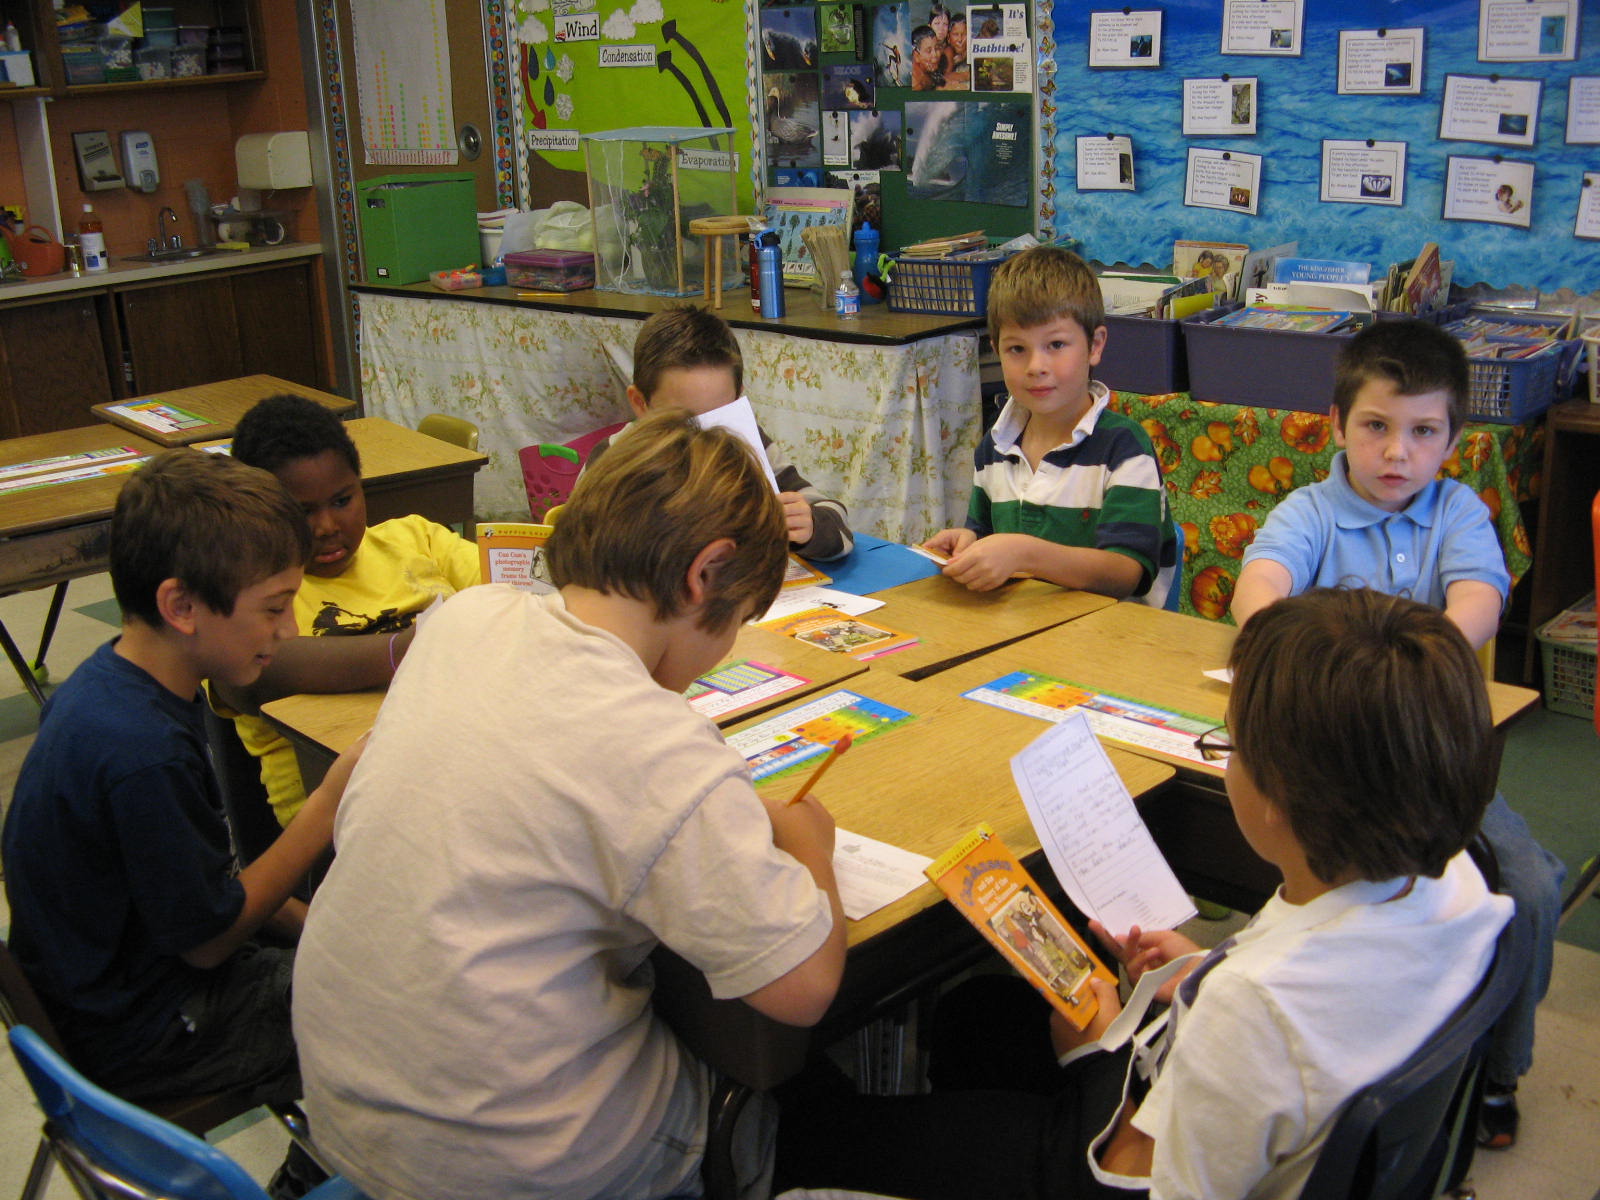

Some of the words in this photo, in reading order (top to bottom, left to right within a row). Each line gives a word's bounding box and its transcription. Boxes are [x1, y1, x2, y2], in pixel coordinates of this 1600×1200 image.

[1008, 9, 1024, 19] It's
[565, 20, 597, 38] Wind
[602, 48, 653, 63] Condensation
[531, 135, 577, 149] Precipitation
[1292, 271, 1318, 280] YOUNG
